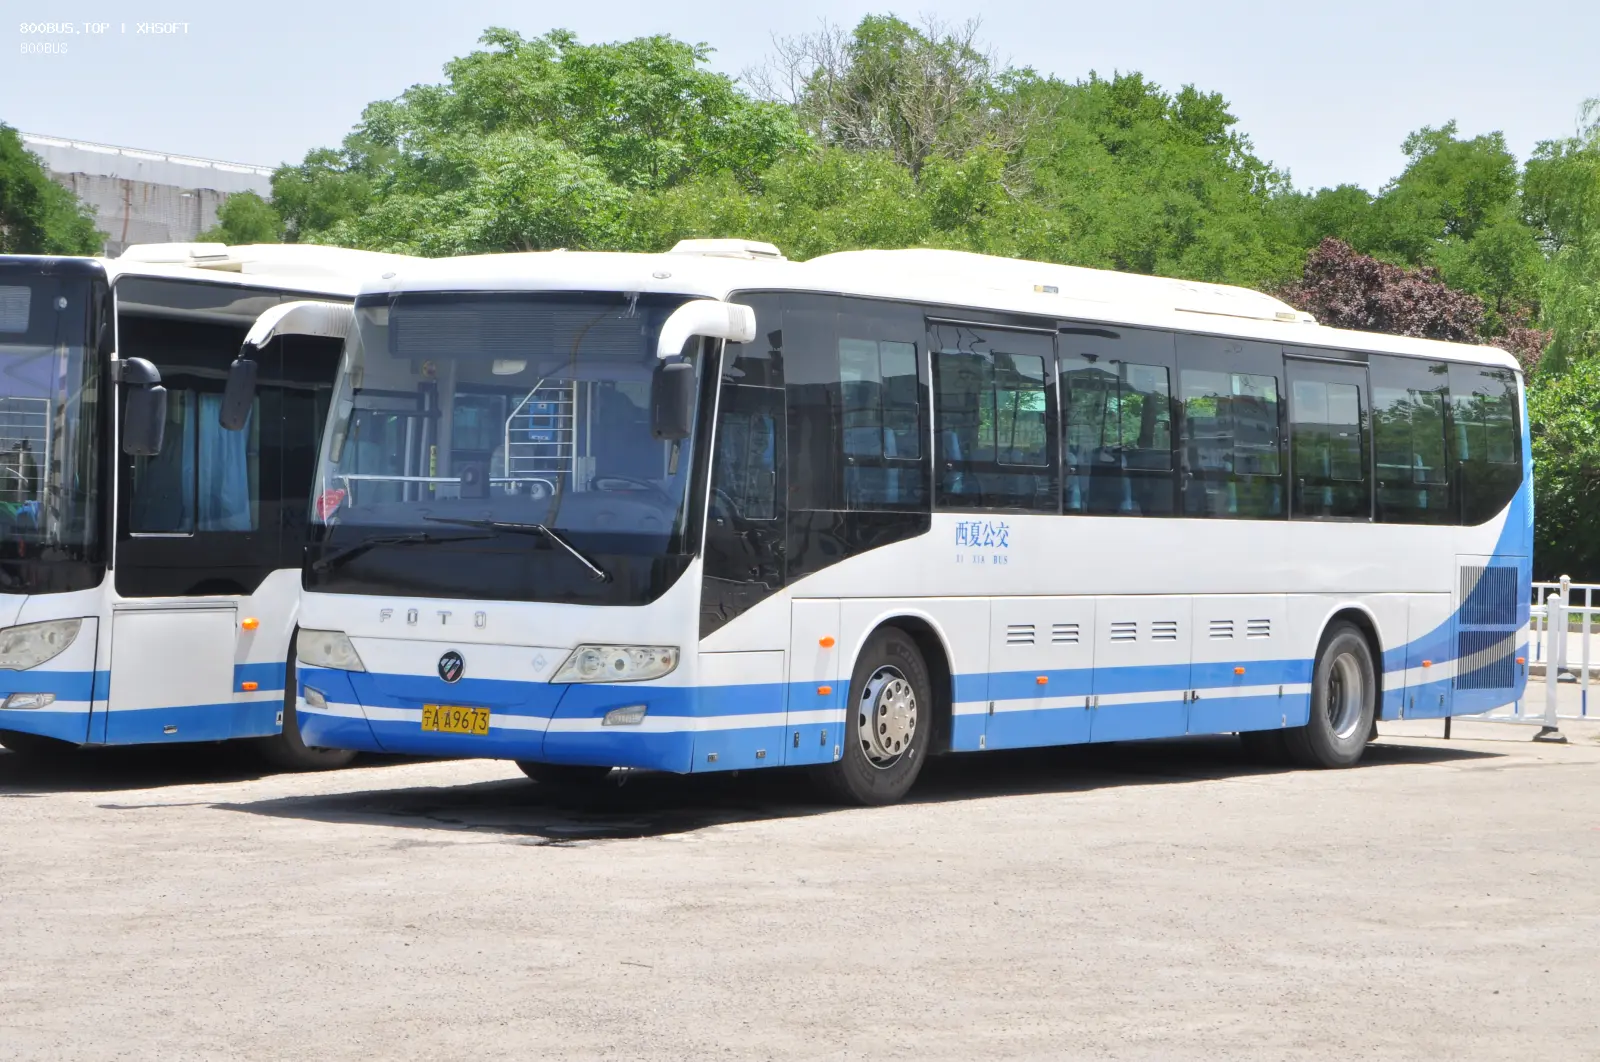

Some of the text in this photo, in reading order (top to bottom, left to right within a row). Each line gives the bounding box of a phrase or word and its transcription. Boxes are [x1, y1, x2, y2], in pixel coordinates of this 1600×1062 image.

[955, 521, 1010, 548] 西夏公交
[993, 555, 1008, 565] BUS
